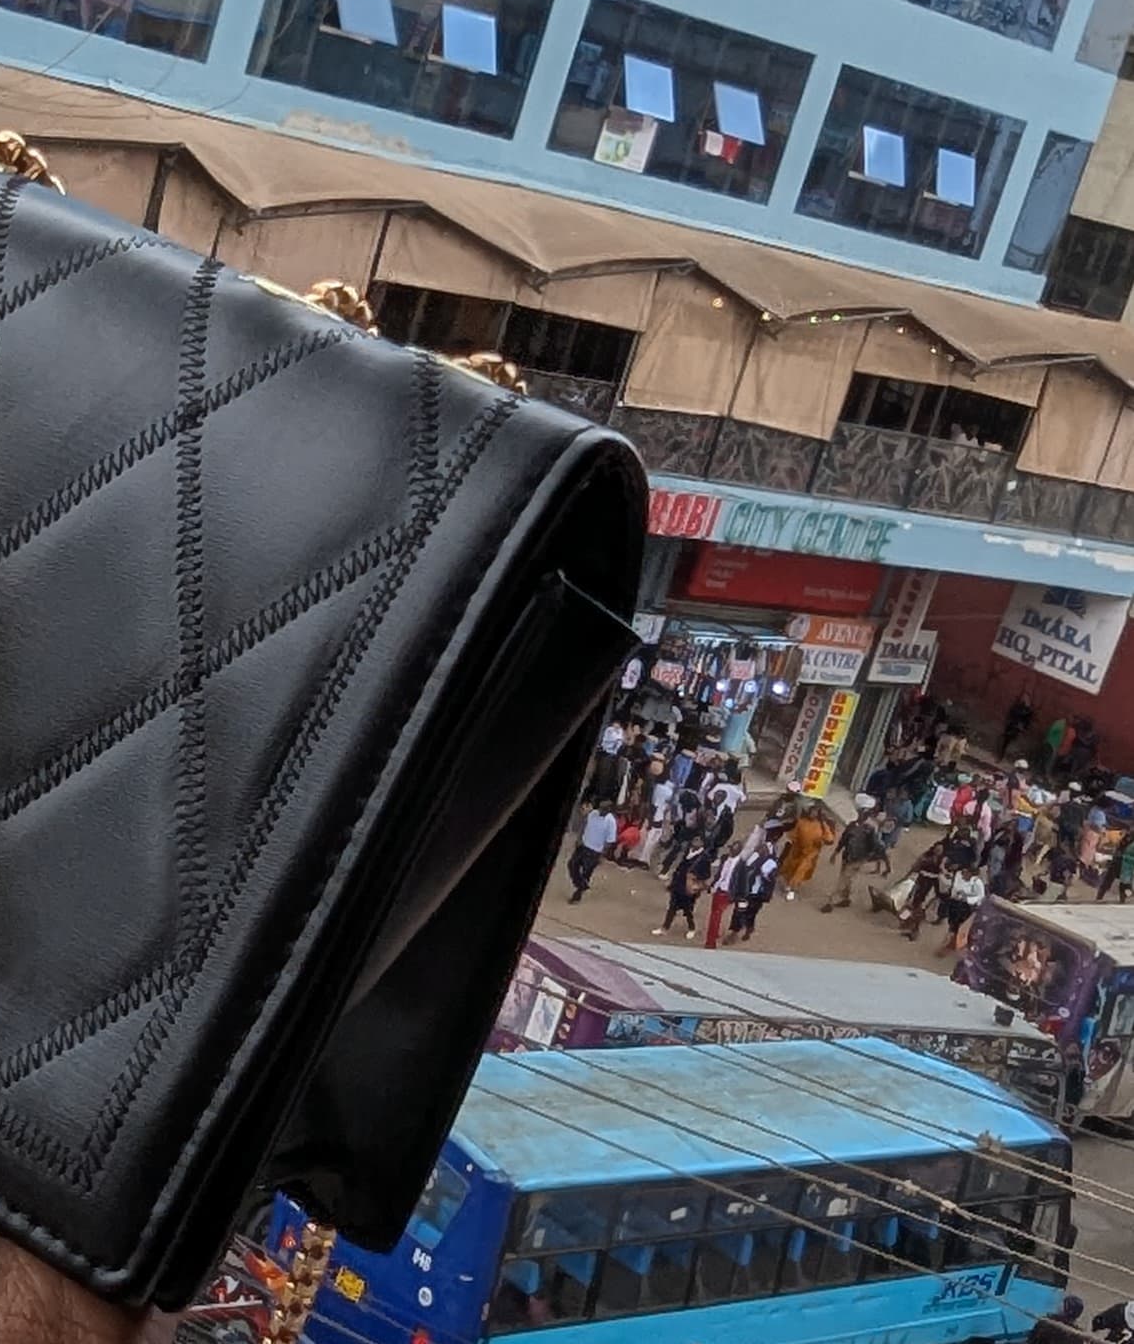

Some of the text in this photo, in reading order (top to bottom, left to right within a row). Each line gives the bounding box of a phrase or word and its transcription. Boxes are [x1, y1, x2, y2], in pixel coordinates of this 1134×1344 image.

[648, 490, 723, 538] ROBI
[724, 502, 793, 545] CITY
[1020, 608, 1092, 653] IMARA
